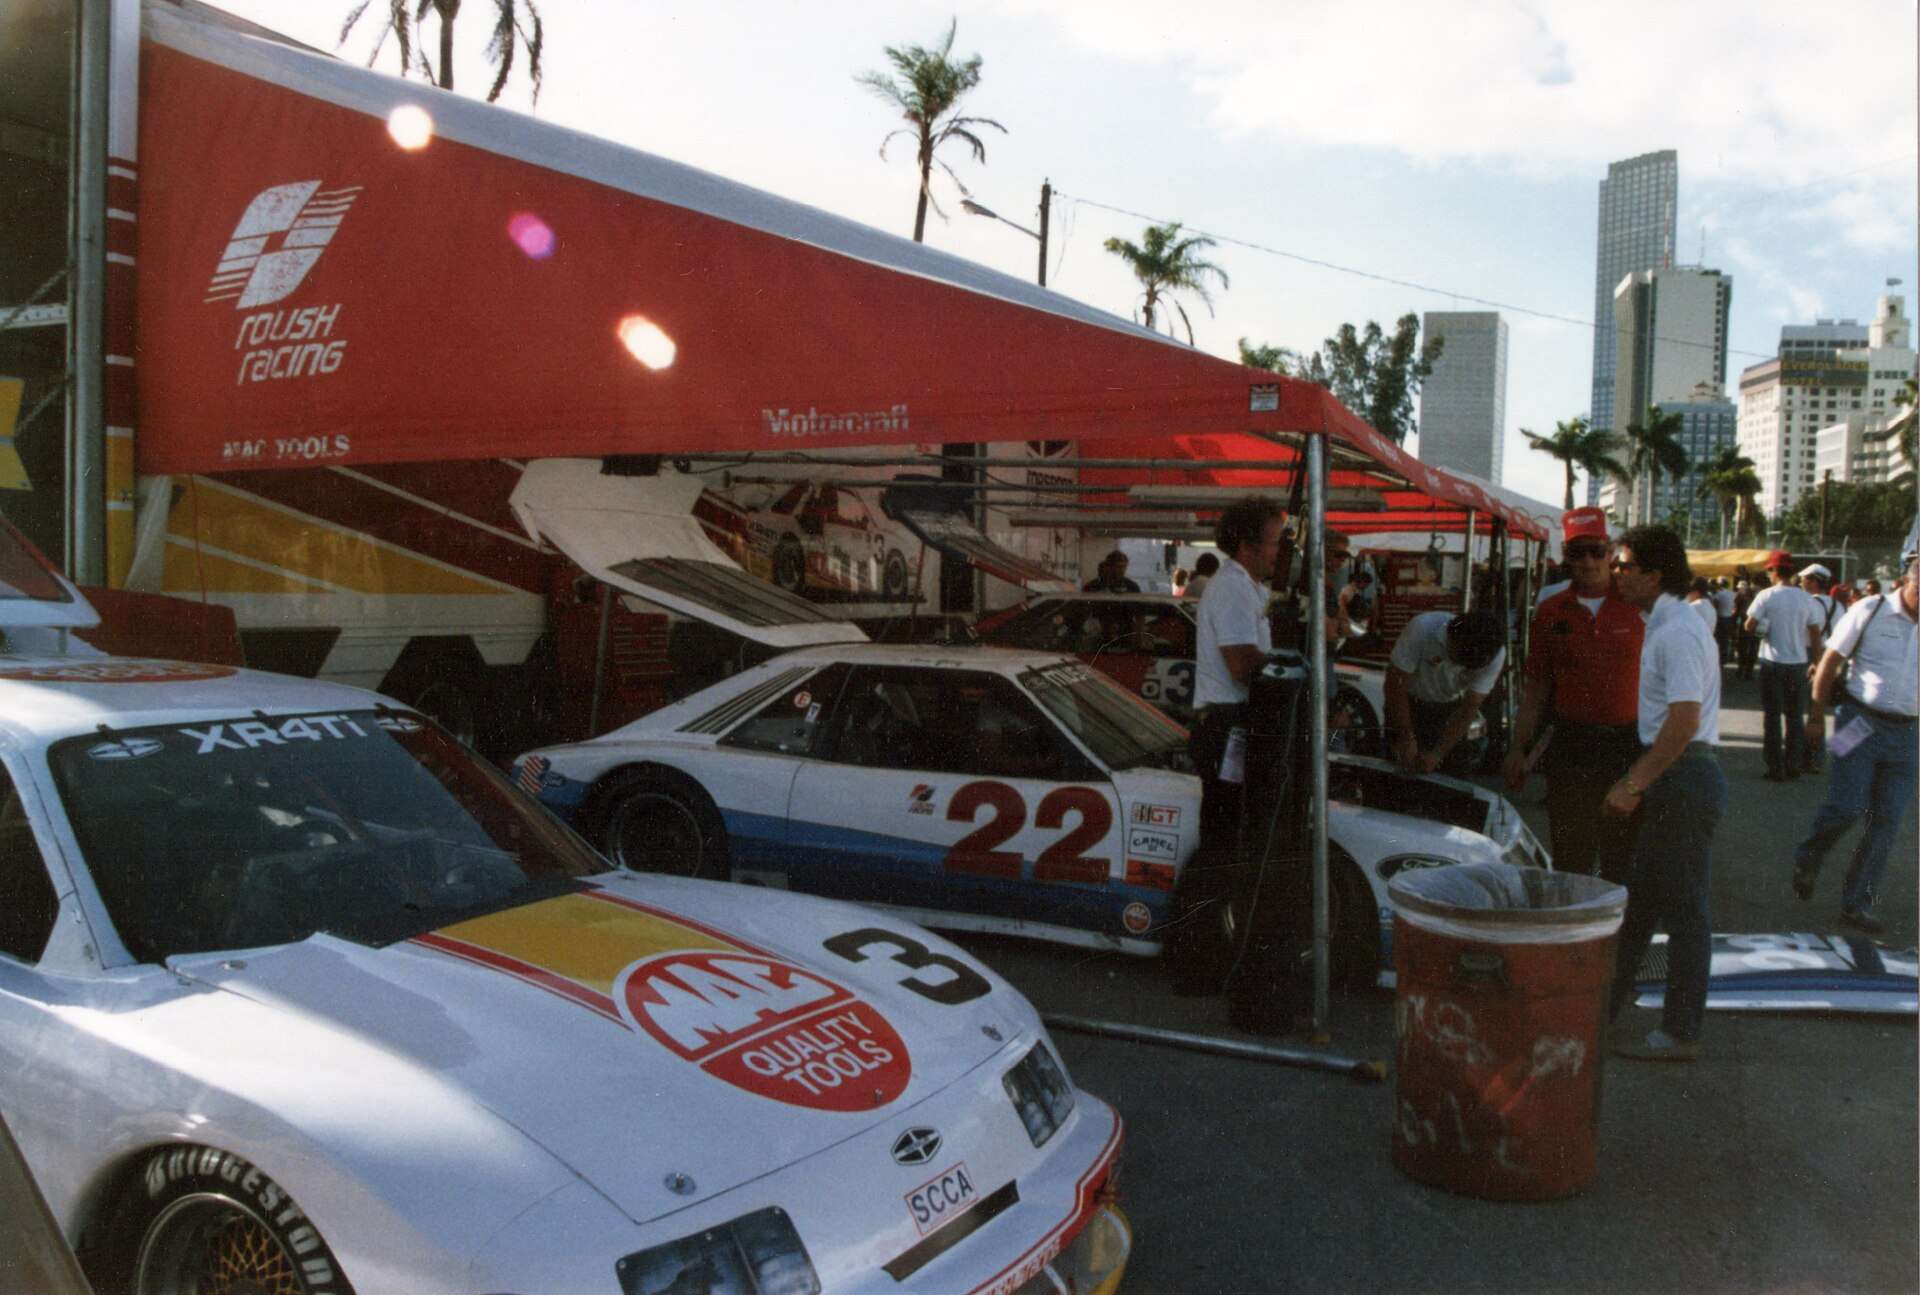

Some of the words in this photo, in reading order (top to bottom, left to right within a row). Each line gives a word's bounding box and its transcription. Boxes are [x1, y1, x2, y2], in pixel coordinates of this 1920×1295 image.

[275, 434, 351, 460] TOOLS
[180, 713, 368, 754] XR4Ti
[944, 780, 1113, 884] 22
[1132, 835, 1174, 852] CAMEL
[822, 928, 992, 1005] 3
[643, 957, 836, 1051] MAC
[741, 1011, 873, 1077] QUALITY
[783, 1038, 894, 1096] TOOLS
[145, 1147, 337, 1295] BRIDGESTON
[911, 1169, 973, 1223] SCCA
